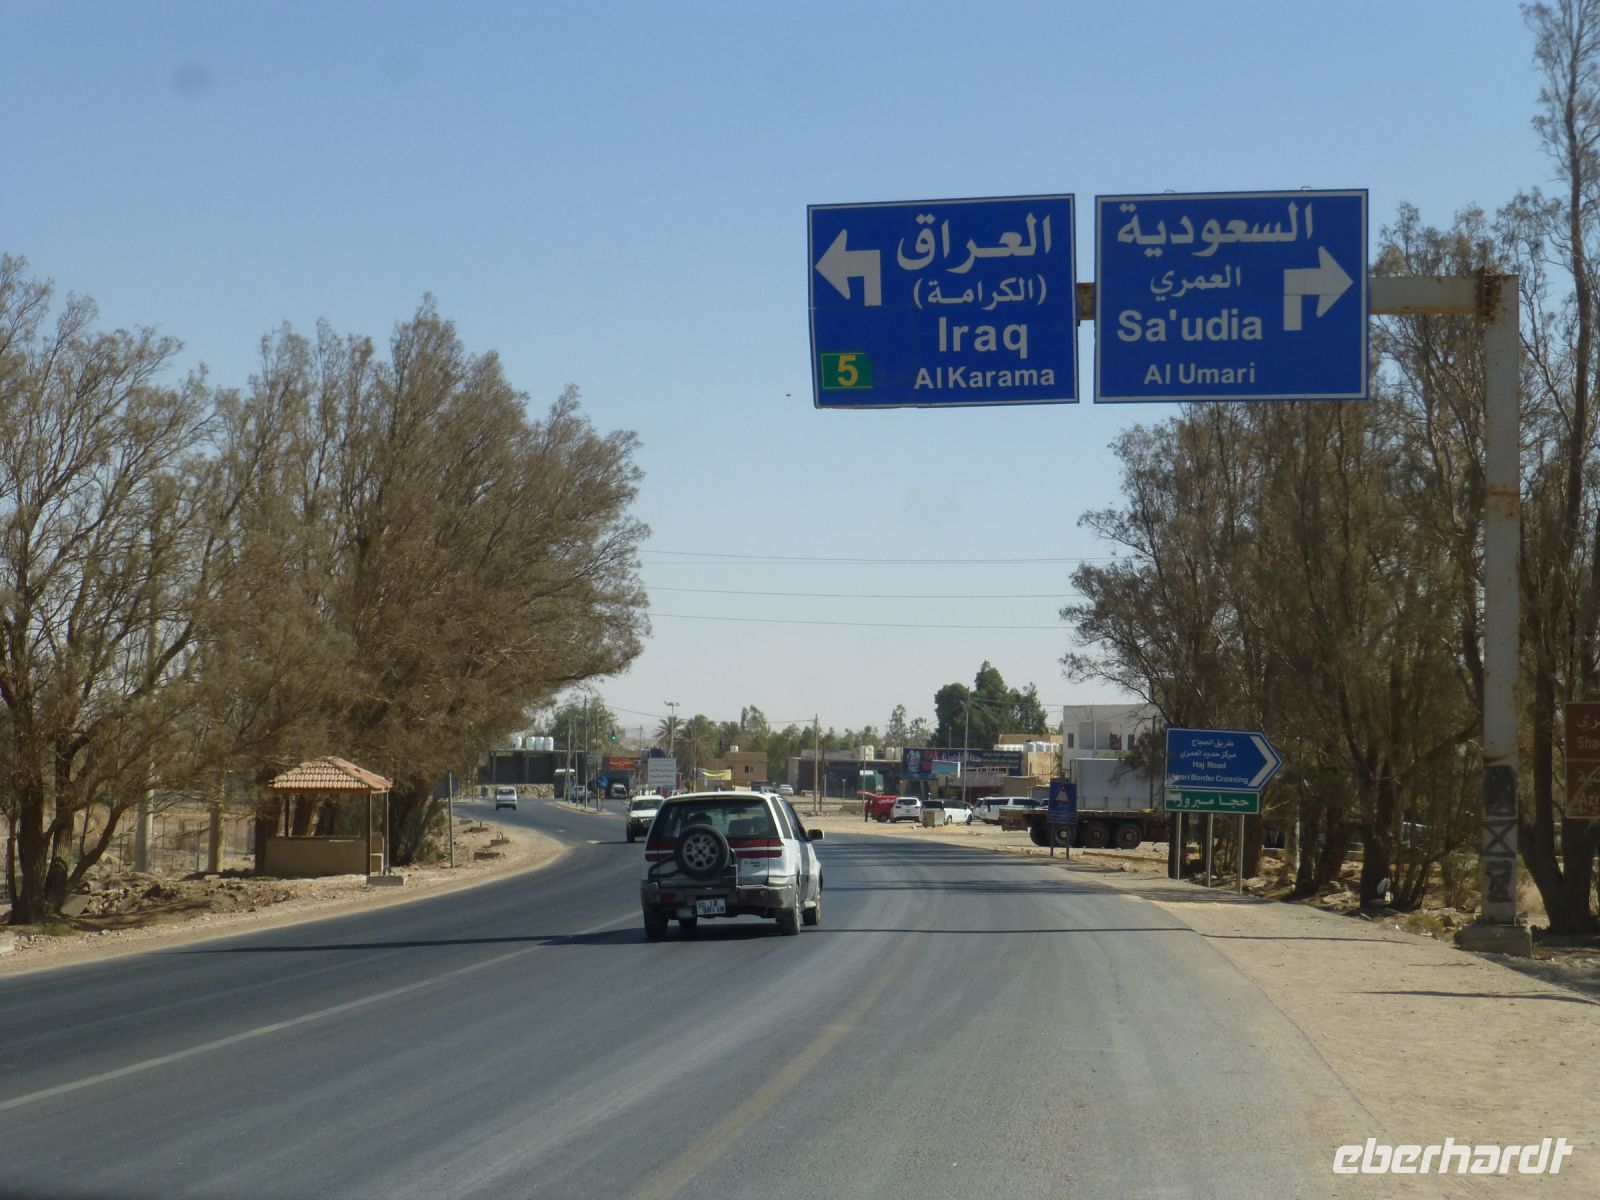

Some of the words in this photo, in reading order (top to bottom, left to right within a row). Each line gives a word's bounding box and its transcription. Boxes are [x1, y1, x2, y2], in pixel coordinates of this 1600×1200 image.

[897, 211, 1052, 274] العراق
[1117, 201, 1313, 258] السعودية
[913, 274, 1047, 310] (الكرامة)
[1150, 264, 1241, 301] العمري
[938, 317, 1028, 359] Iraq
[1116, 308, 1263, 342] Sa'udia
[837, 354, 858, 387] 5
[948, 366, 1055, 388] Karama
[1143, 363, 1171, 385] Al
[1178, 362, 1256, 384] Umari
[1190, 773, 1215, 781] Border
[1215, 775, 1249, 784] Crossing
[1207, 761, 1226, 769] Road
